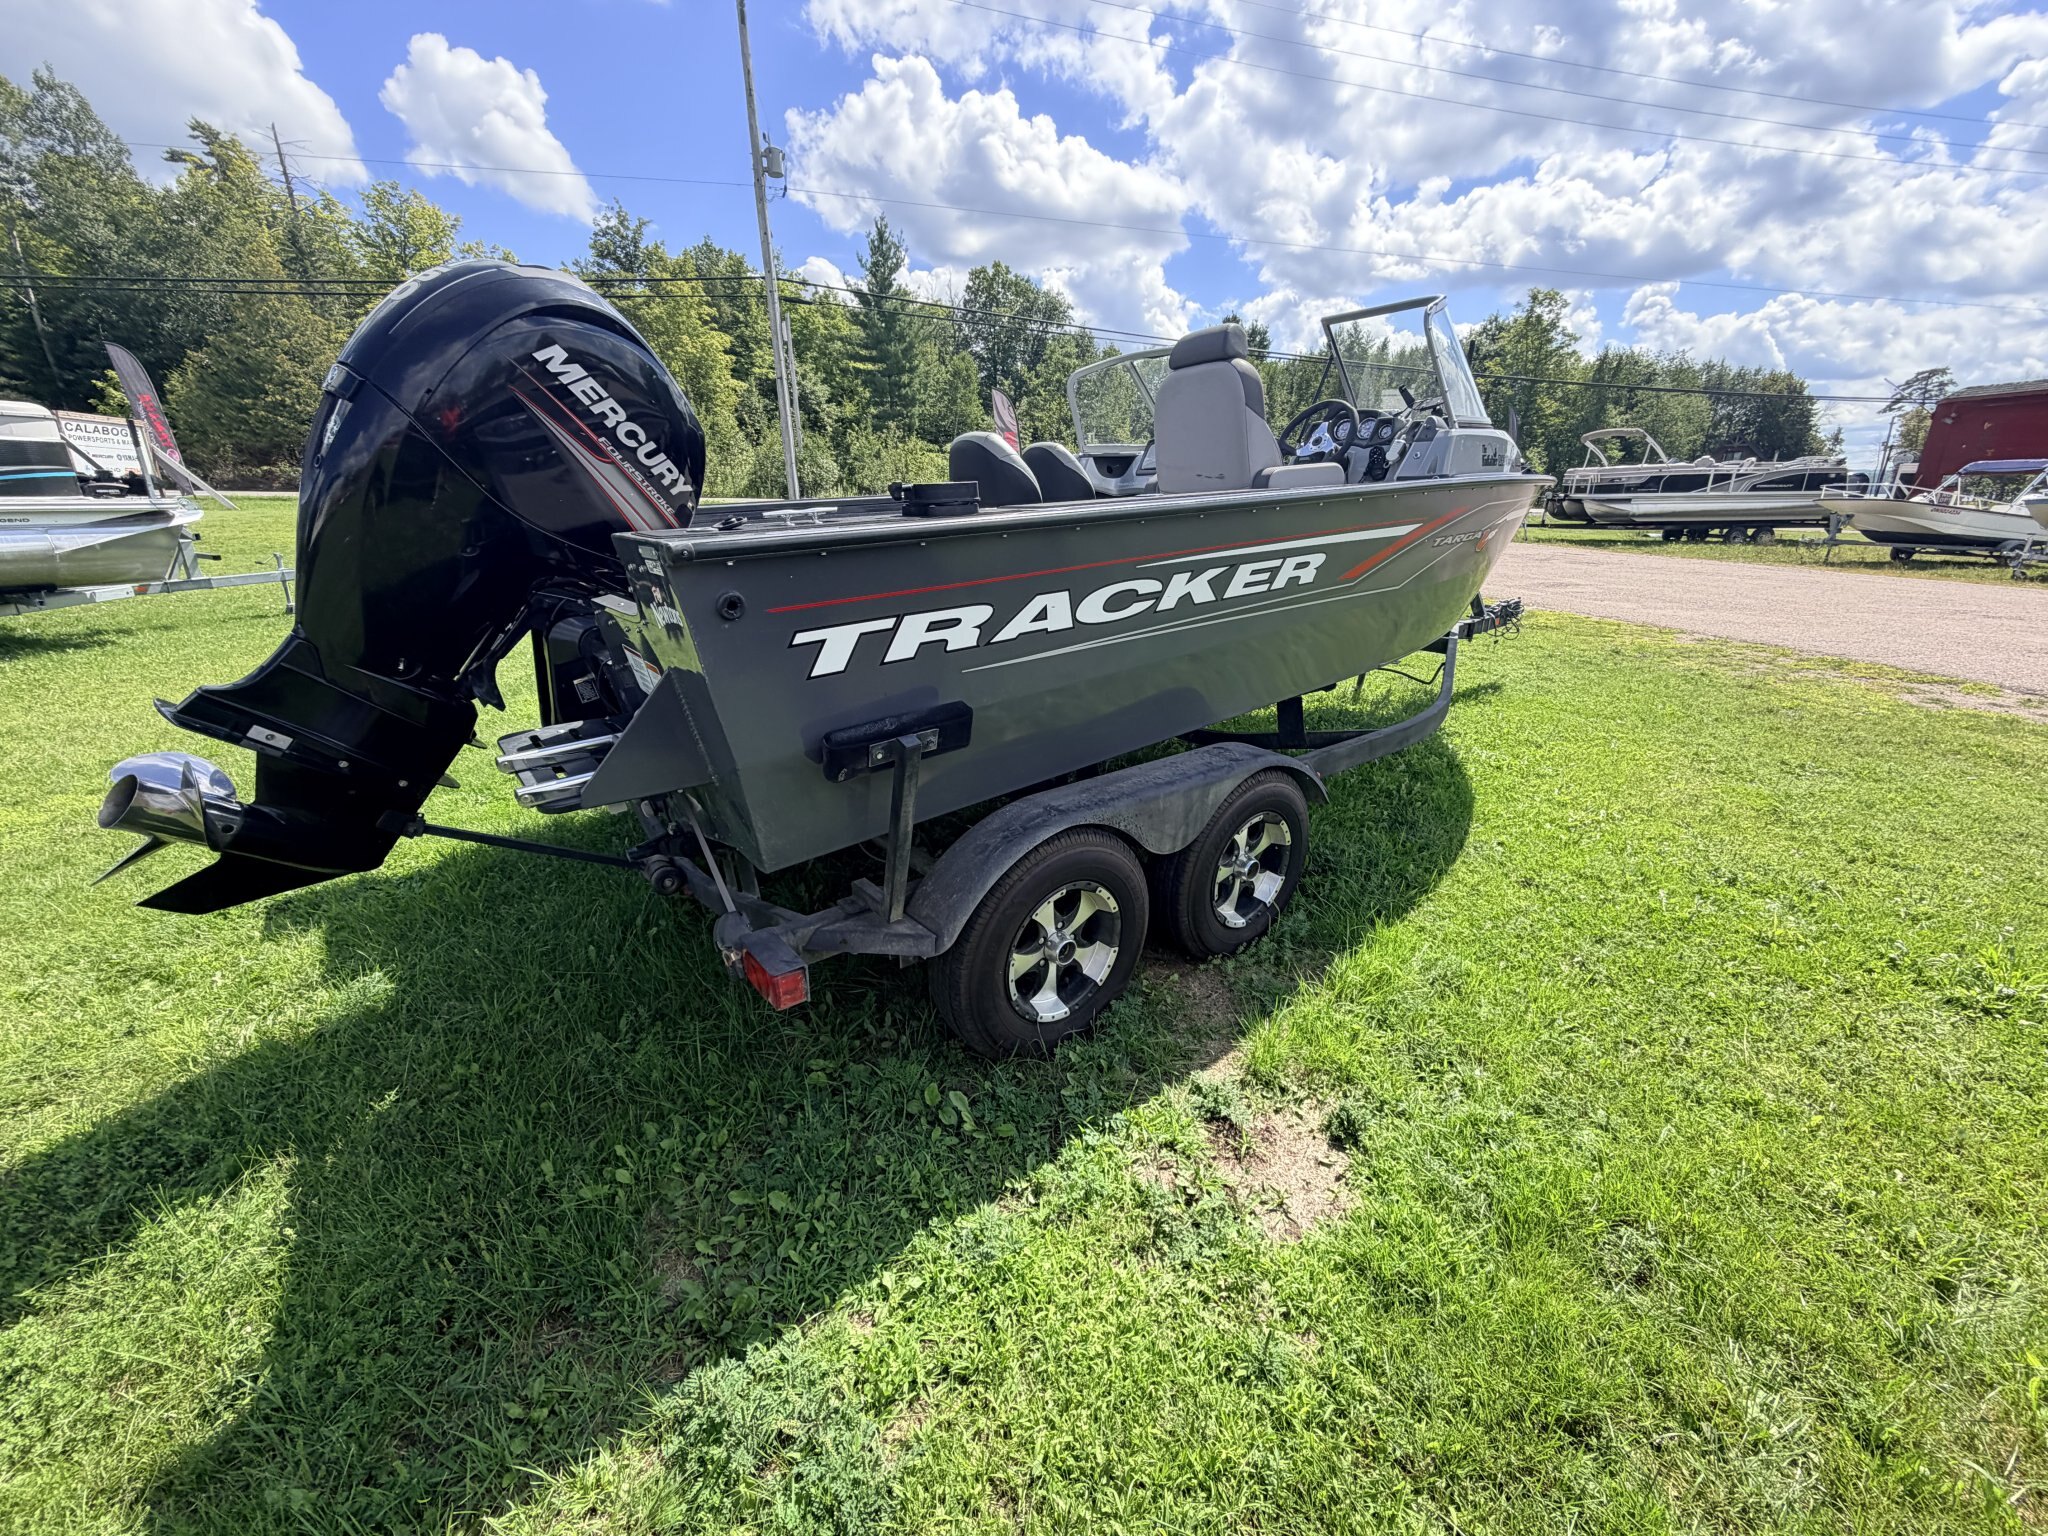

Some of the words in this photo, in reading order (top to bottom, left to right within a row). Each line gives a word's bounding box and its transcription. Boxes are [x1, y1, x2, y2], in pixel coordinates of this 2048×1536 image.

[64, 422, 139, 438] CALABOG
[68, 433, 115, 445] POWERSPORTS
[532, 344, 693, 496] MERCURY
[597, 436, 675, 515] FOURSTROKE
[1432, 530, 1482, 547] TARGA
[787, 552, 1327, 681] TRACKER
